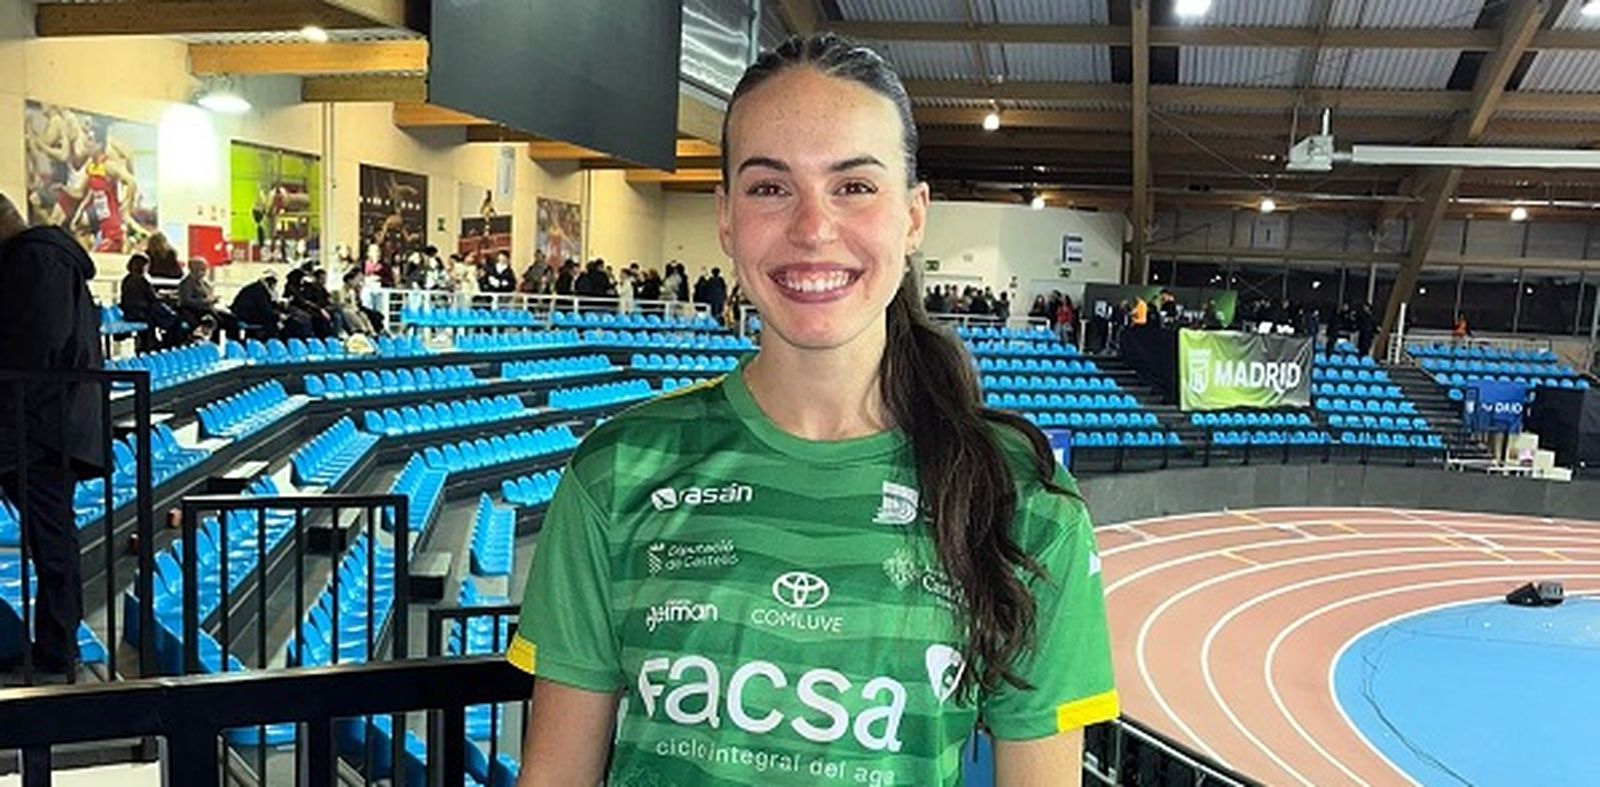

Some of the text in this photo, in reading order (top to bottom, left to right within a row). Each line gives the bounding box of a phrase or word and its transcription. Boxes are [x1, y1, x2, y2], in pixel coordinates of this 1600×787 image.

[1214, 359, 1300, 394] MADRID
[751, 609, 844, 633] COMLUVE
[810, 759, 846, 778] del
